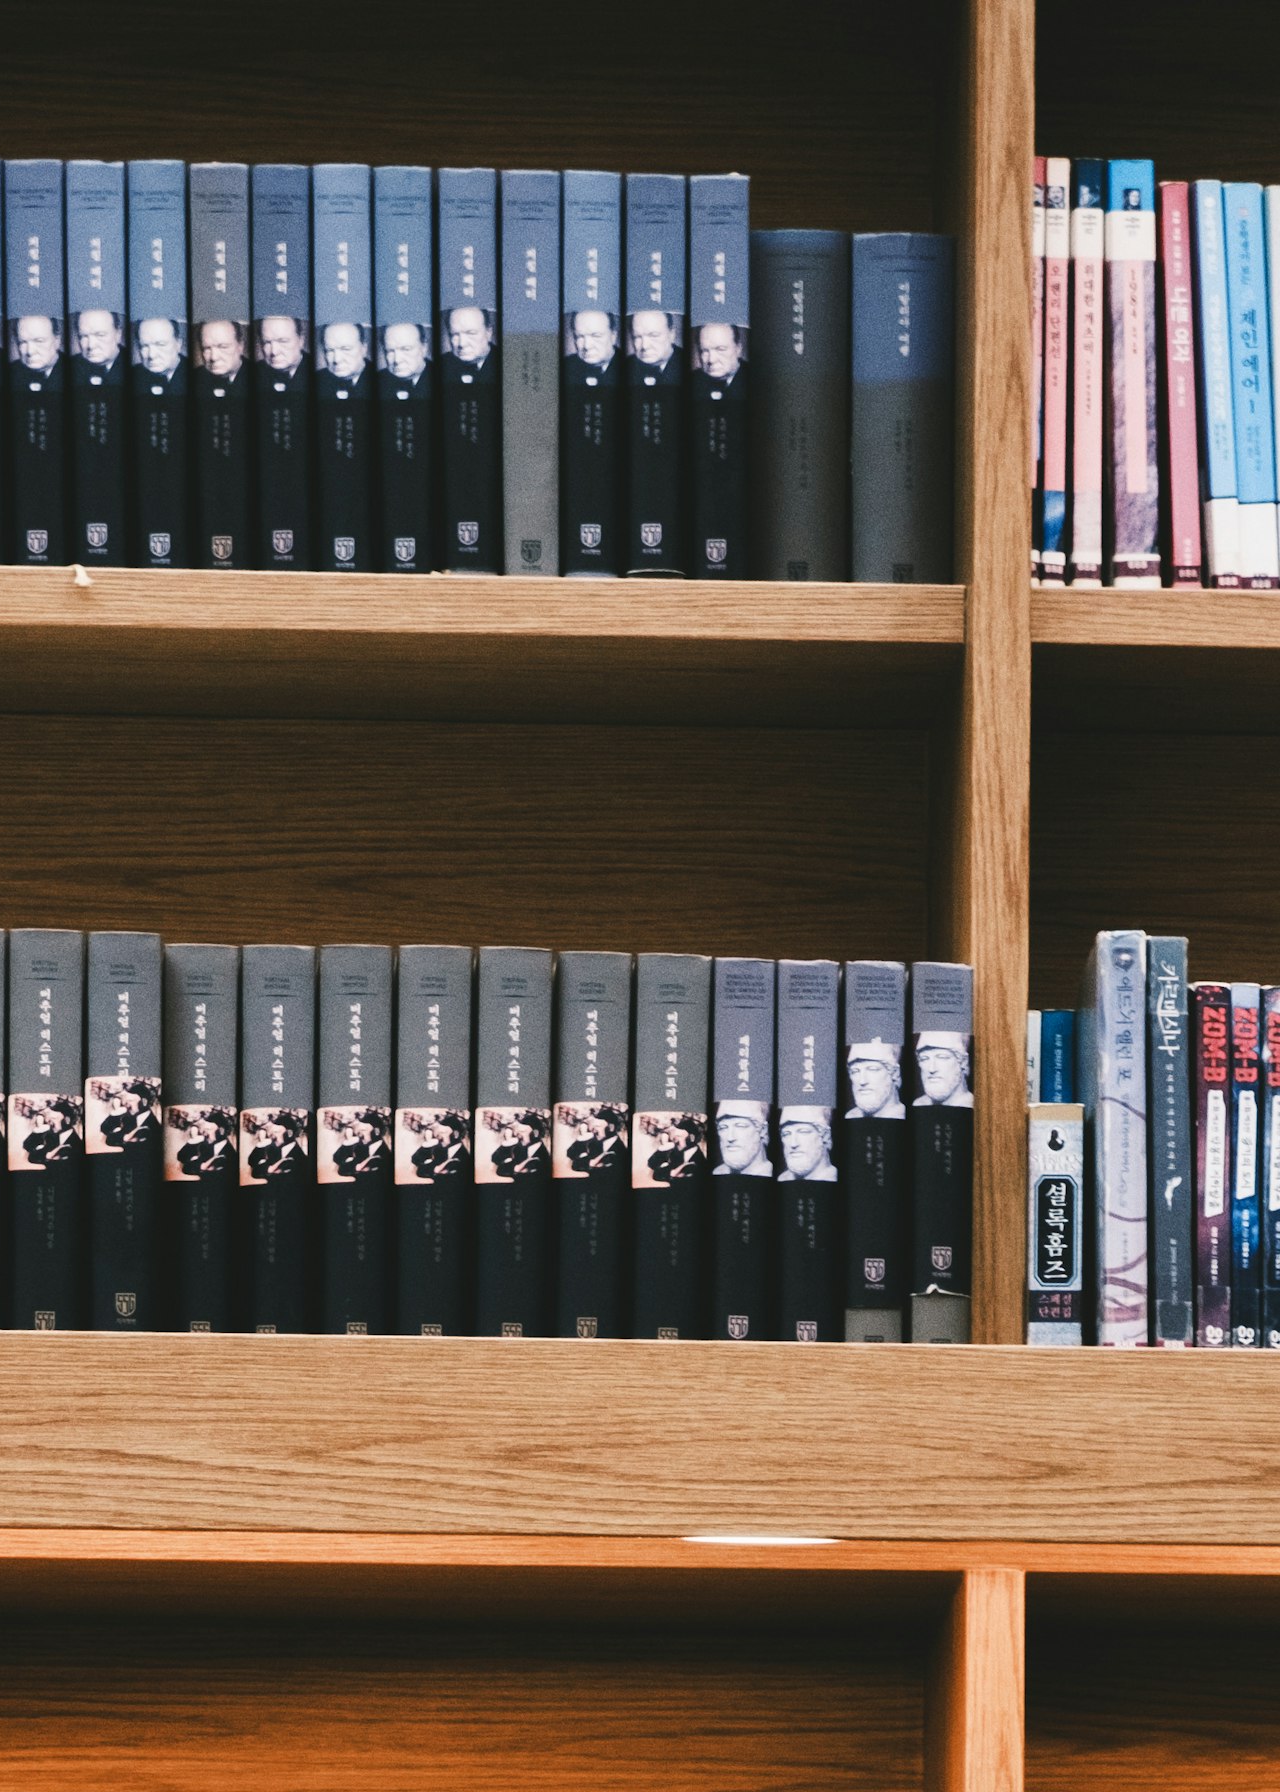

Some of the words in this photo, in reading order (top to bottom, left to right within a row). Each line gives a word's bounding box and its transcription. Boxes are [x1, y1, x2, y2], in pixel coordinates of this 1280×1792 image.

[1169, 285, 1189, 324] 나쁜
[1171, 326, 1191, 364] 여자
[1200, 1005, 1228, 1085] ZOM-B
[1232, 1005, 1258, 1084] ZOM-B
[1043, 1182, 1069, 1279] 셜록홈즈
